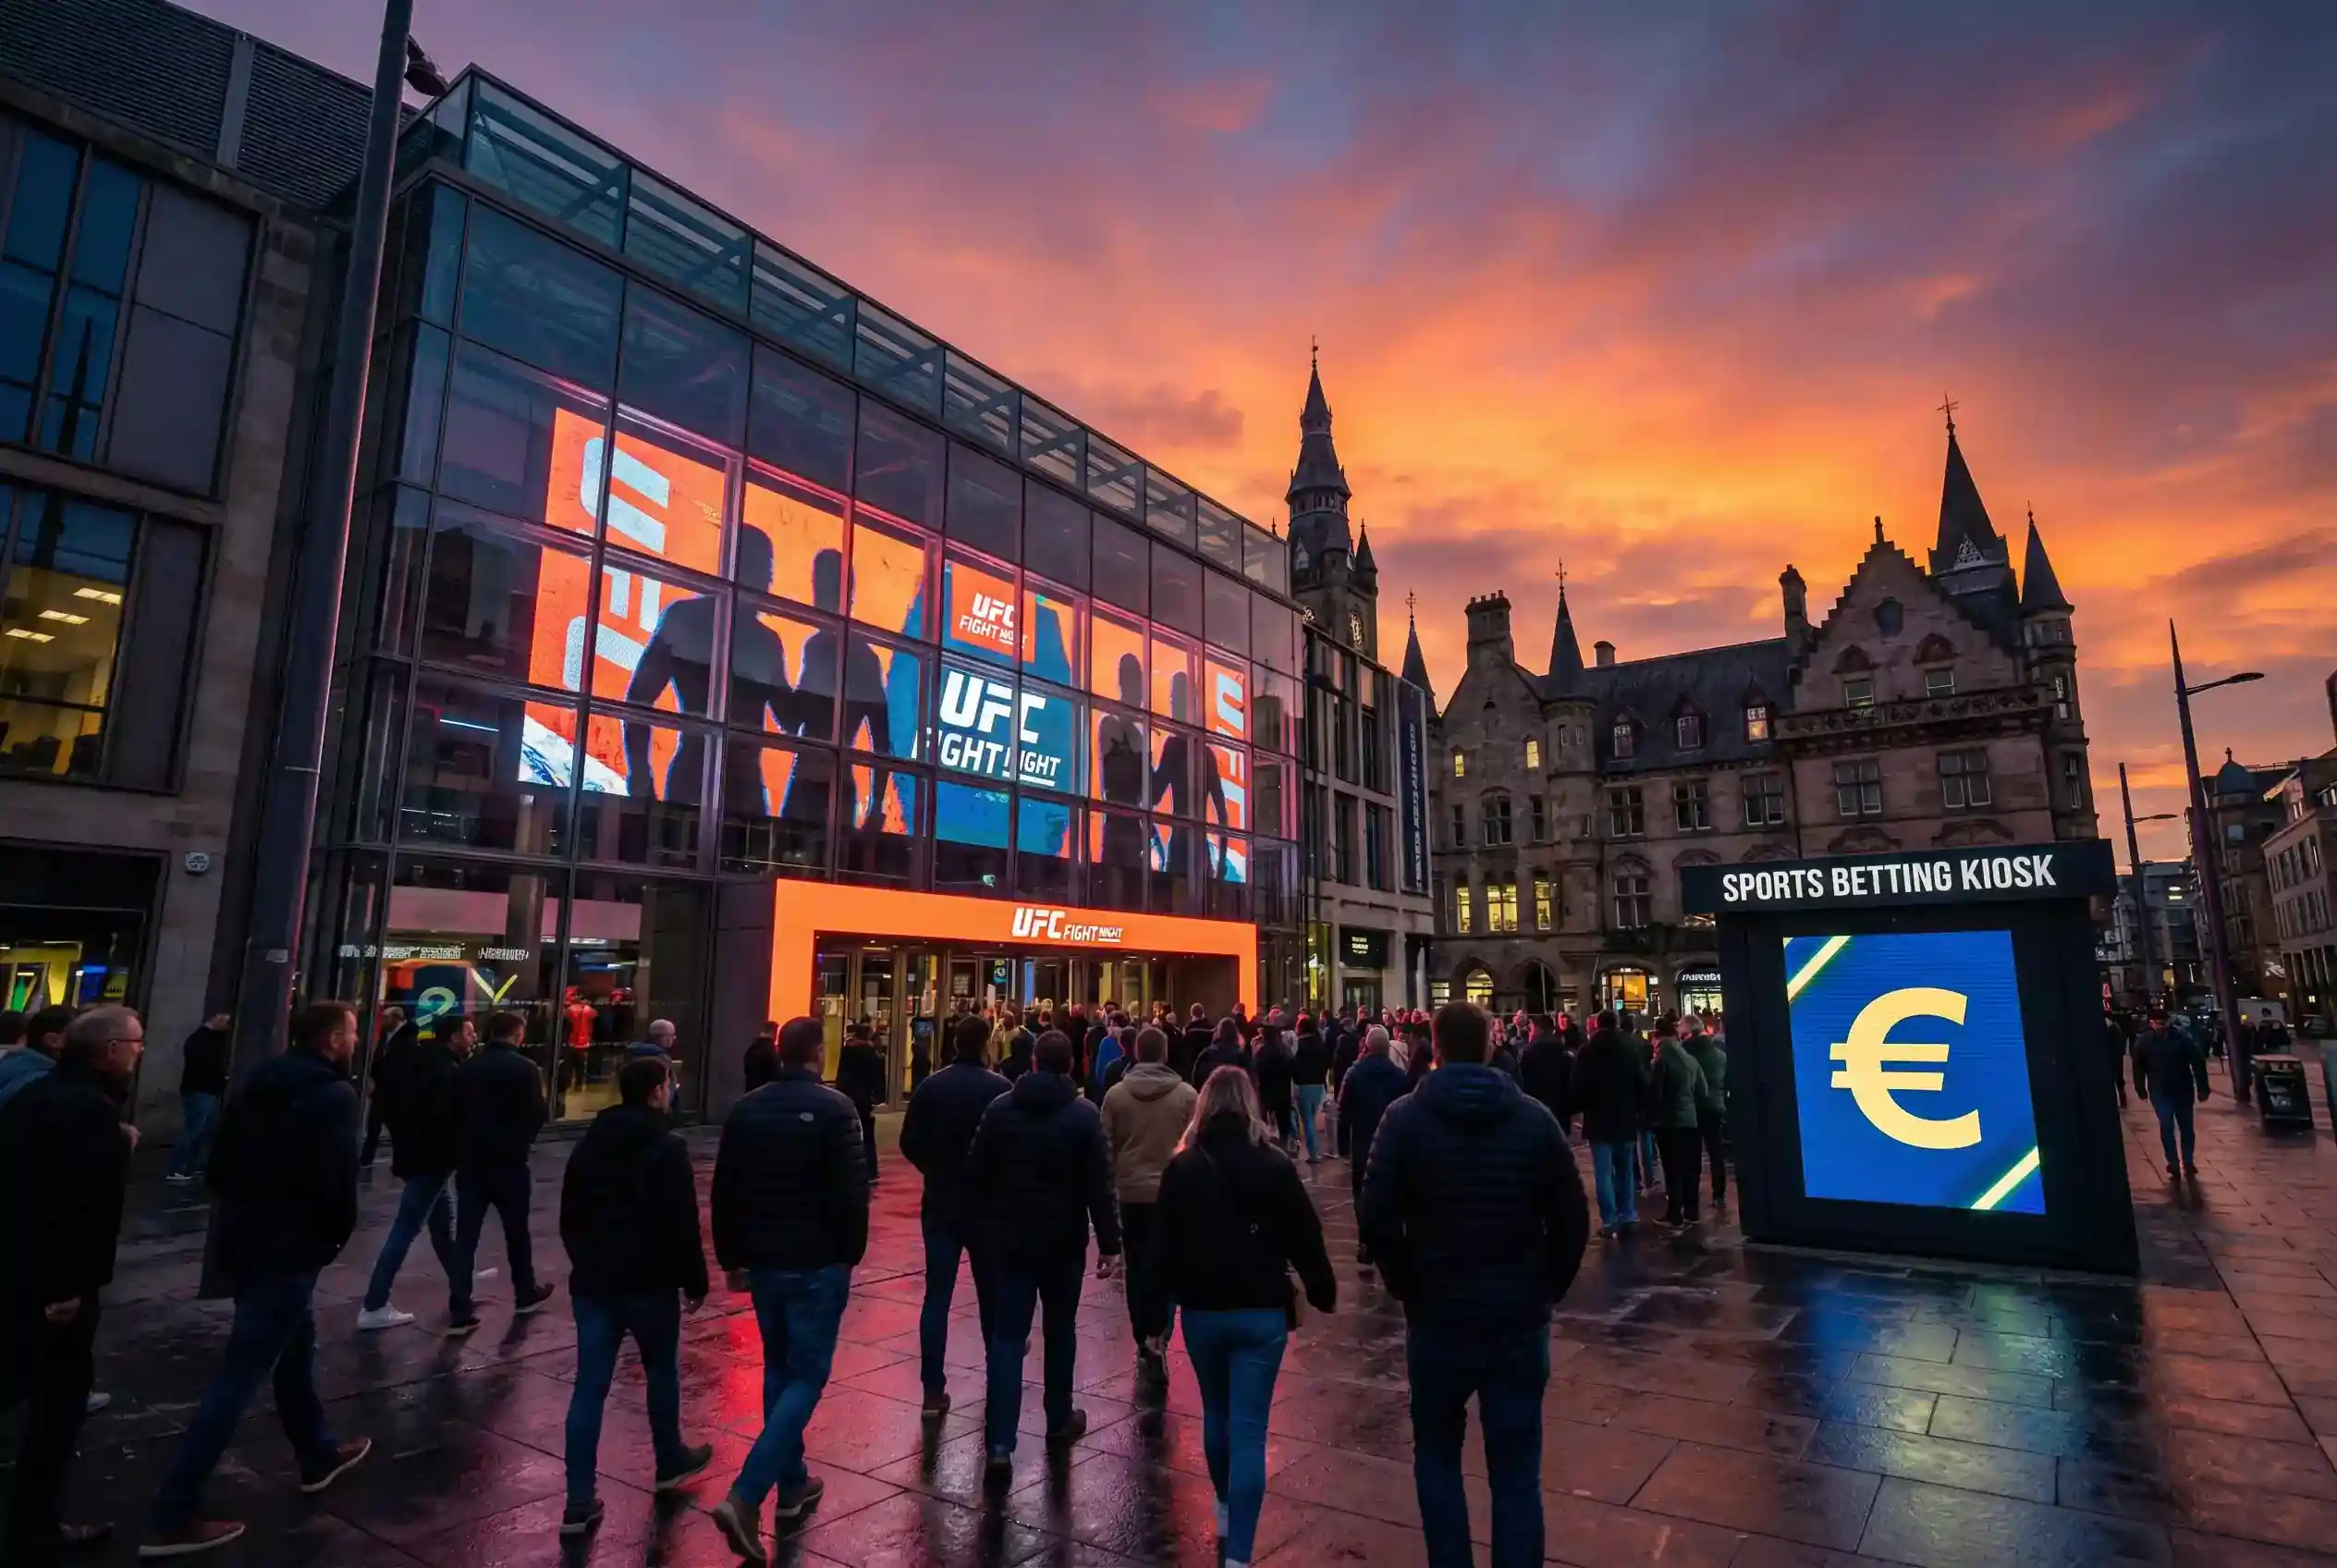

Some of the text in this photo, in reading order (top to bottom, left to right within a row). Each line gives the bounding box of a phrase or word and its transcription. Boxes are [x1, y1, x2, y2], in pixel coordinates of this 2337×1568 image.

[959, 615, 1000, 640] FIGHT
[972, 593, 1015, 629] UFC
[940, 670, 1046, 744] UFC
[1722, 854, 2057, 902] SPORTS BETTING KIOSK
[1011, 907, 1124, 942] UFC FIGHT NIGHT
